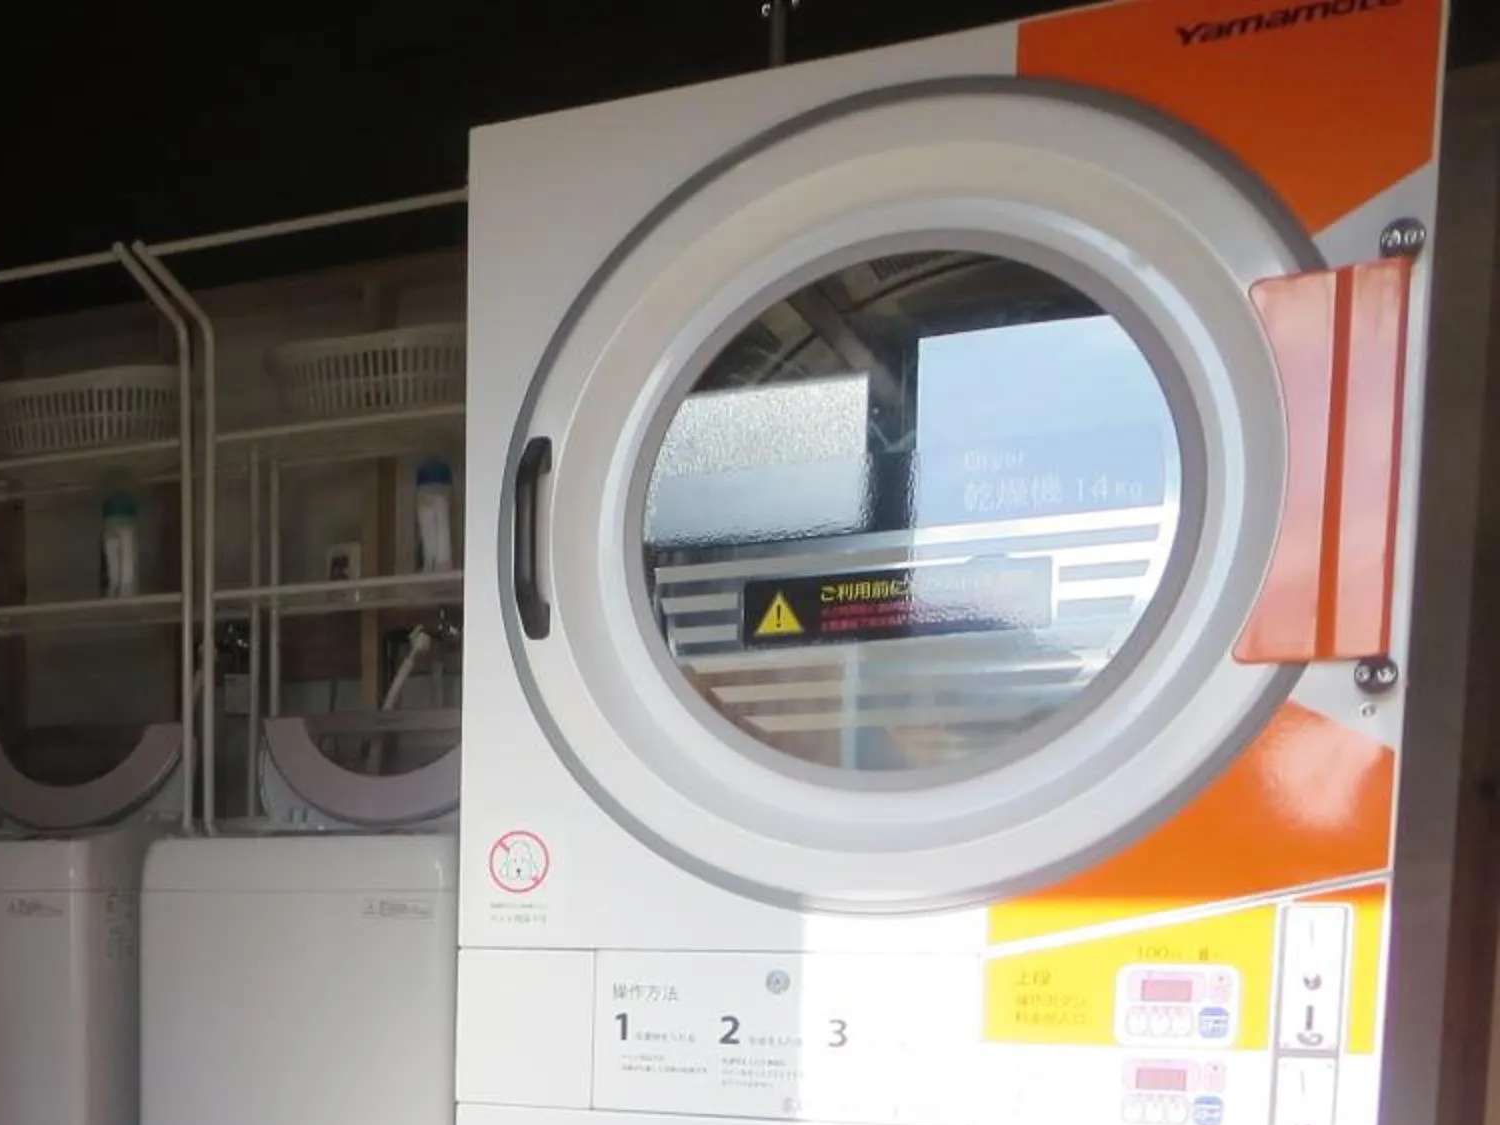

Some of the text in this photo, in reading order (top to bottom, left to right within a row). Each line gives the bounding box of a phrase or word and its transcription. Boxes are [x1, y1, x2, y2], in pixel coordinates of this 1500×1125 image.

[612, 983, 680, 1002] 操作方法
[615, 1012, 628, 1041] 1
[718, 1015, 740, 1045] 2
[826, 1018, 850, 1049] 3
